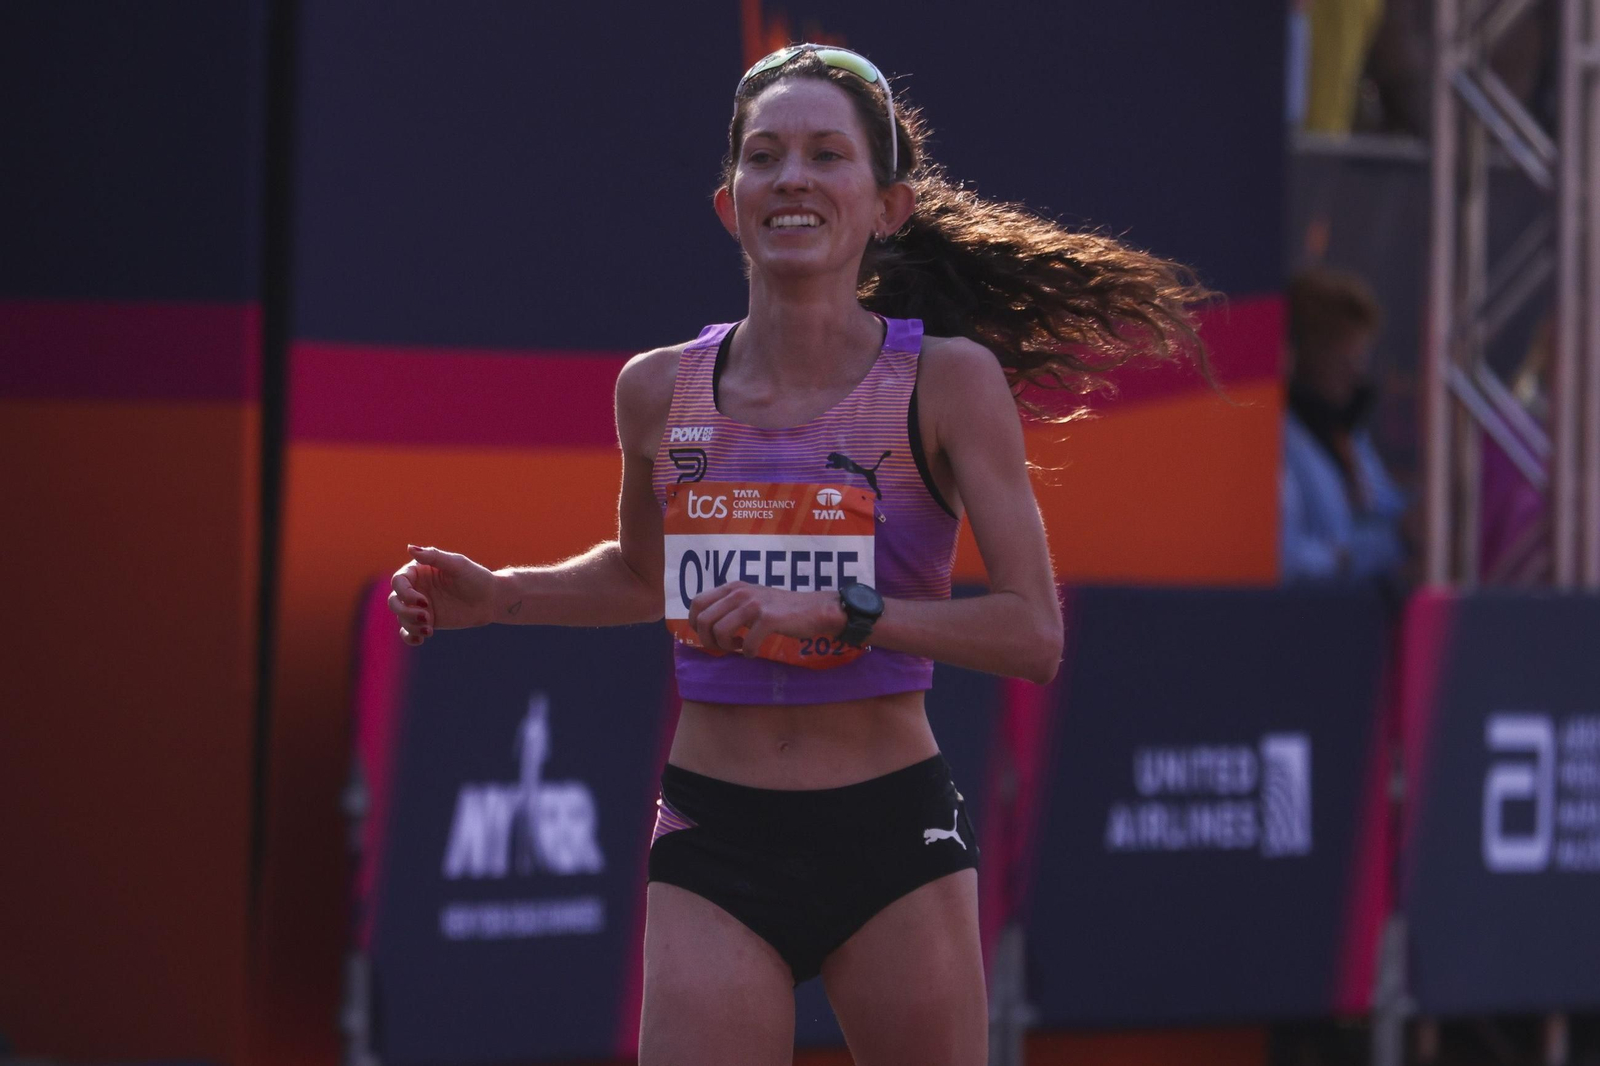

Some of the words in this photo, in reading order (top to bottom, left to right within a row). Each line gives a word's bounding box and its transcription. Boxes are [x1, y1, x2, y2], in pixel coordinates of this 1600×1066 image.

[732, 489, 761, 498] TATA
[687, 489, 728, 519] tcs
[732, 500, 796, 509] CONSULTANCY
[732, 510, 774, 519] SERVICES
[812, 509, 846, 520] TATA
[799, 636, 851, 656] 202
[1132, 746, 1257, 795] UNITED
[1106, 802, 1258, 850] AIRLINES
